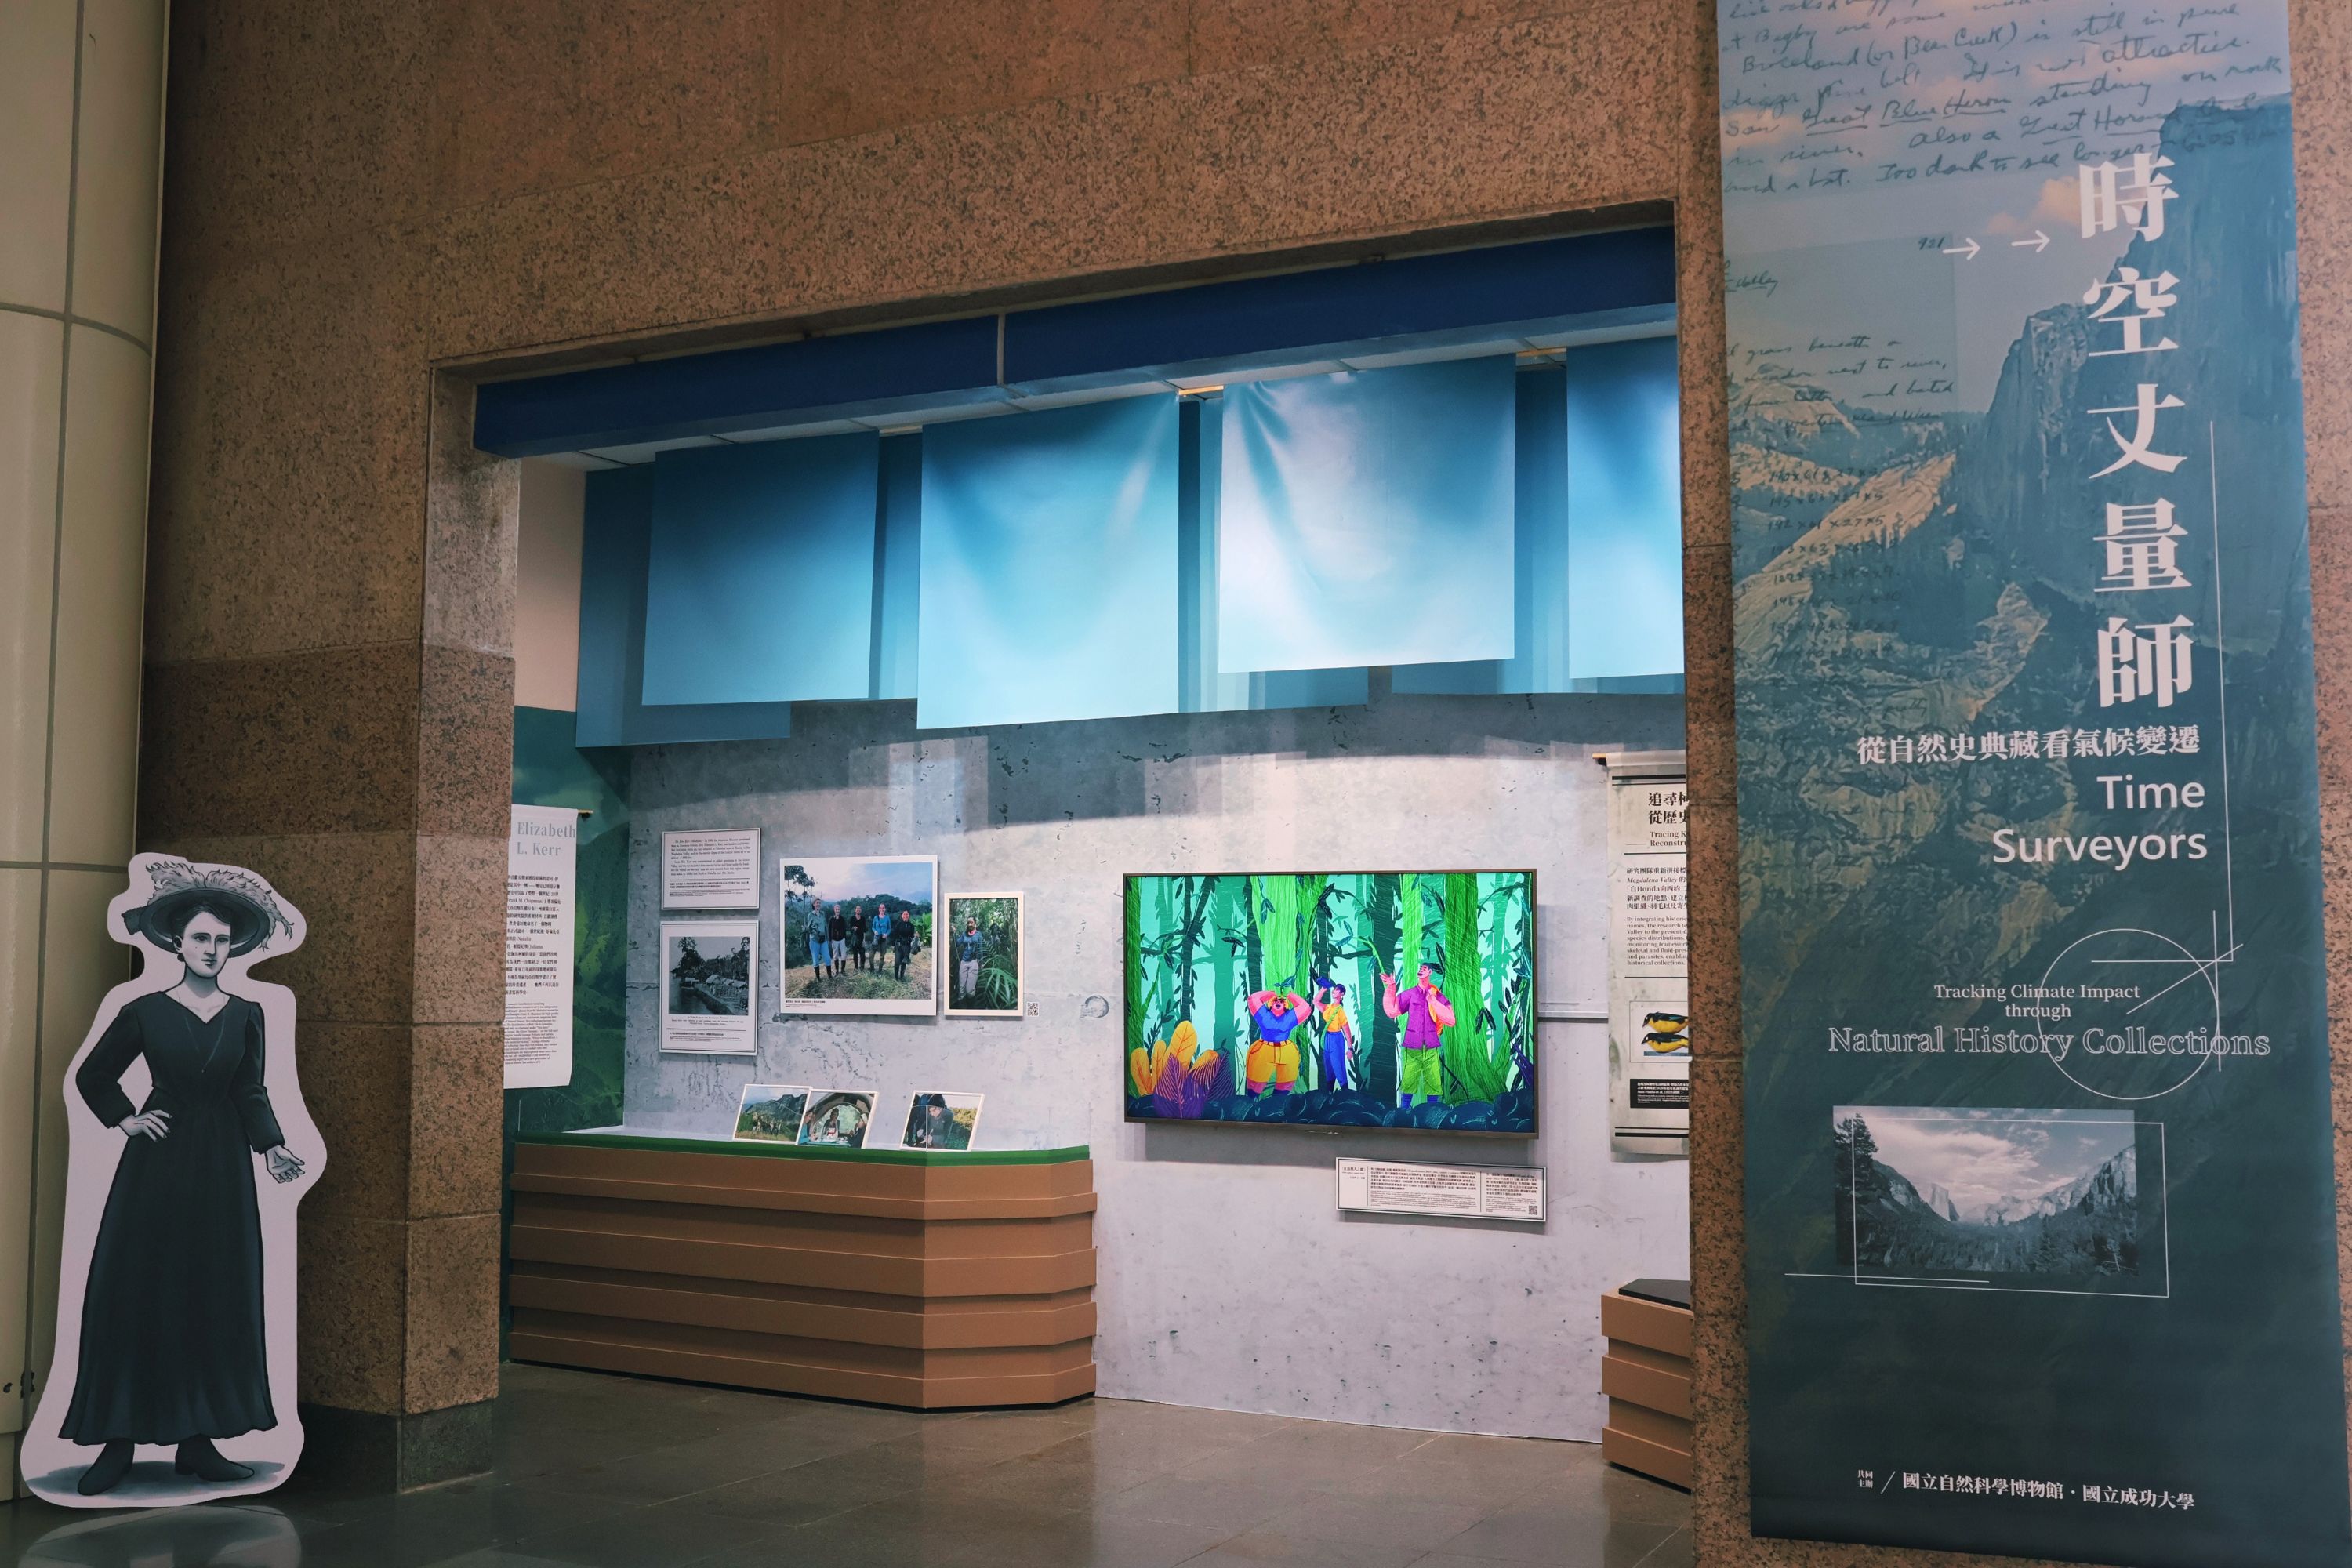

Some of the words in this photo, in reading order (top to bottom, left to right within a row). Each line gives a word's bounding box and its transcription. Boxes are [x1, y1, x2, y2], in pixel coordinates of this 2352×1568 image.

[2078, 152, 2194, 709] 時空丈量師
[1857, 724, 2201, 765] 從自然史典藏看氣候變遷
[2096, 774, 2205, 810] Time
[517, 822, 576, 838] Elizabeth
[1650, 830, 1679, 839] Tracing
[517, 842, 528, 855] L.
[533, 843, 561, 856] Kerr
[1992, 829, 2208, 872] Surveyors
[1934, 985, 2006, 1002] Tracking
[2010, 985, 2075, 999] Climate
[2080, 985, 2140, 1002] Impact
[2005, 1003, 2071, 1022] through
[1828, 1025, 1946, 1053] Natural
[1954, 1025, 2075, 1062] History
[2082, 1026, 2271, 1056] Collections
